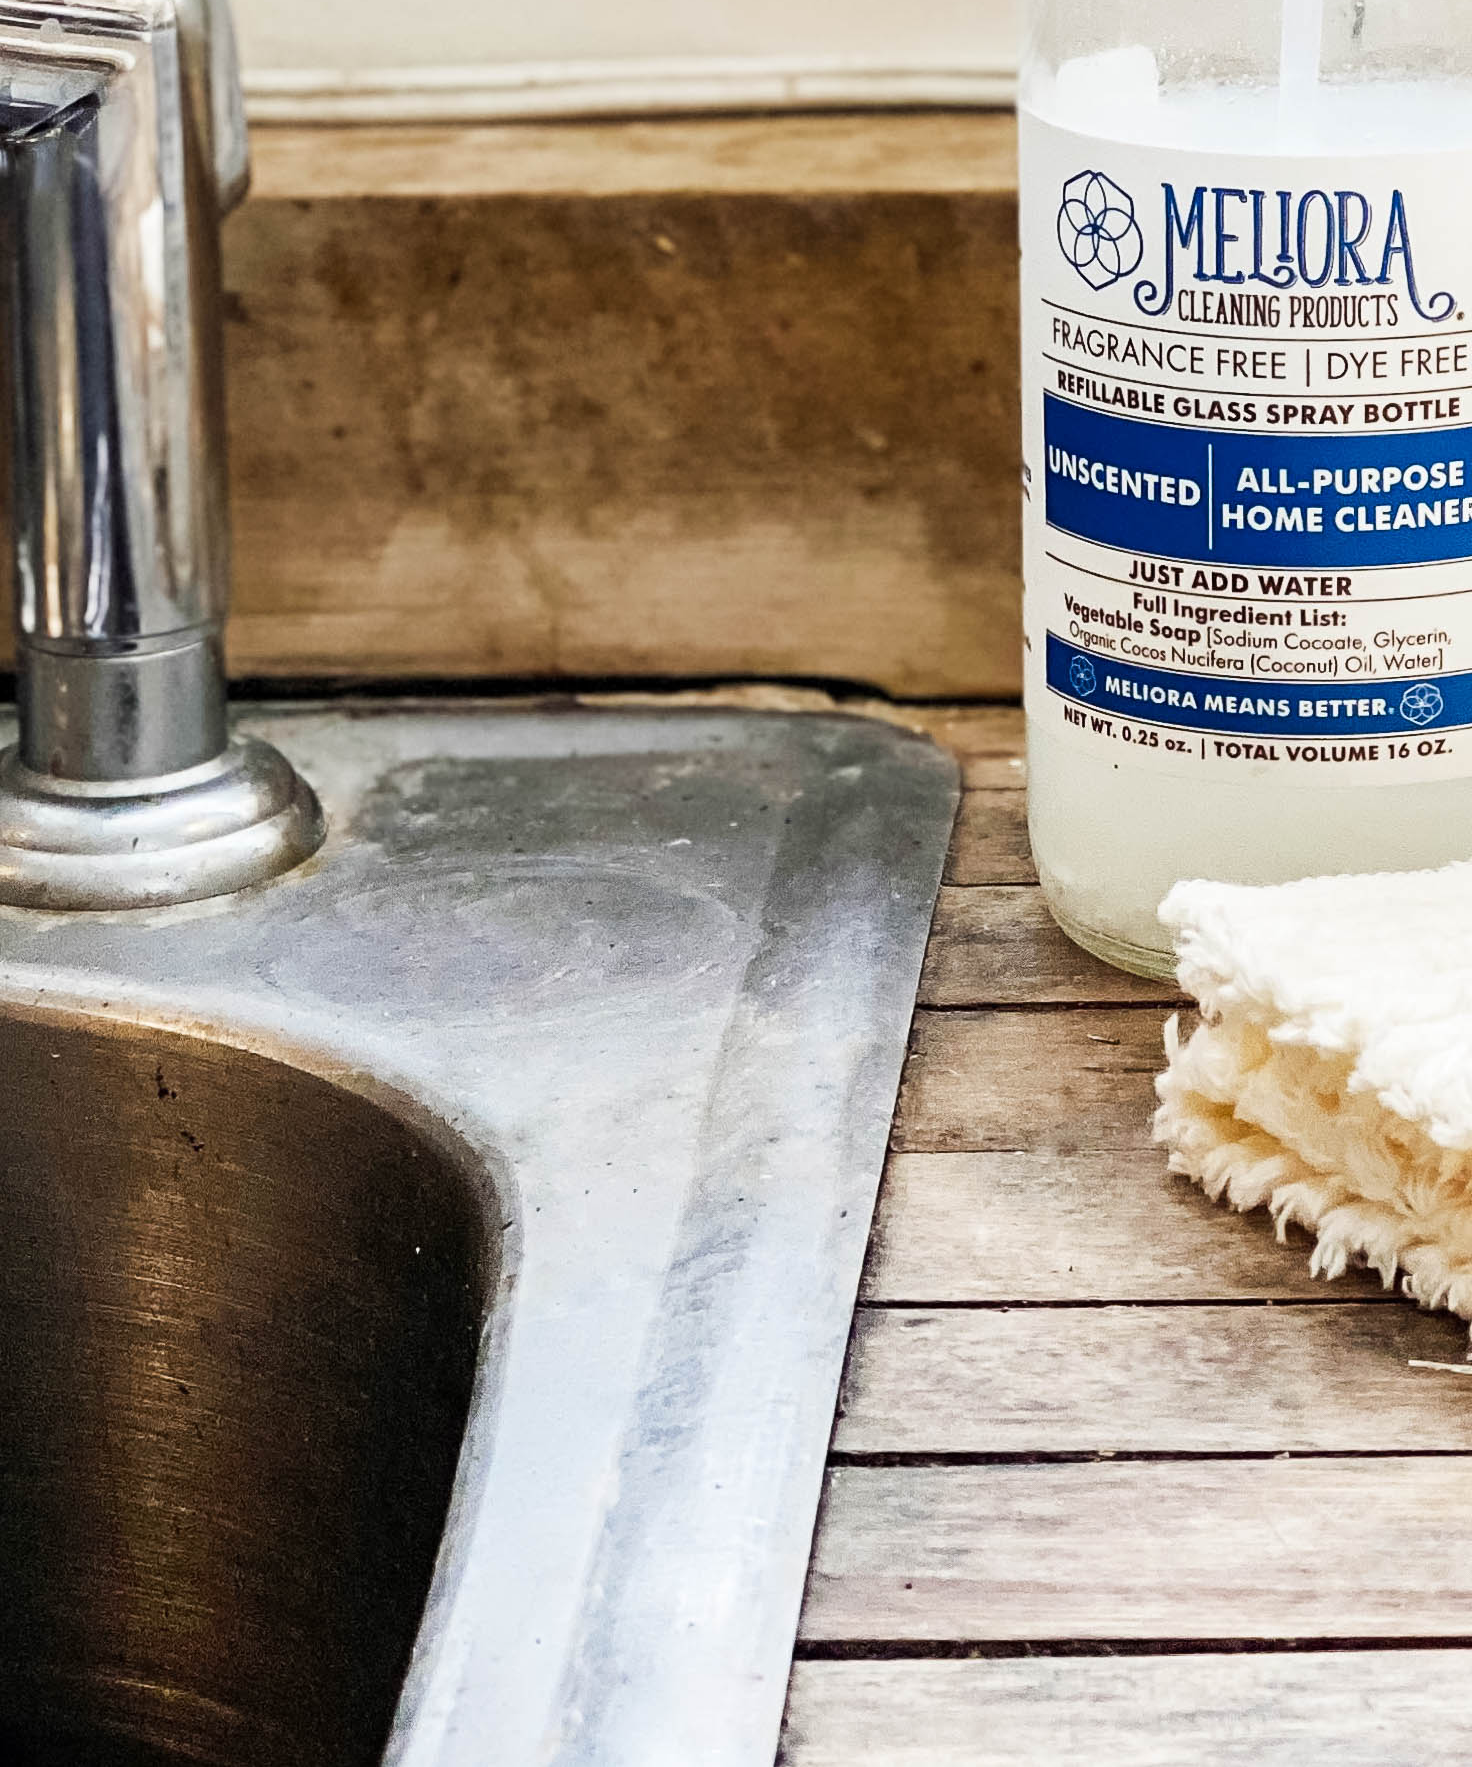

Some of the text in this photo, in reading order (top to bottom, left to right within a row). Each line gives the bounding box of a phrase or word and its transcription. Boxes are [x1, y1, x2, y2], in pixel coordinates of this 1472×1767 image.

[1178, 289, 1399, 328] CLEANING PRODUCTS
[1052, 317, 1468, 380] FRAGRANCE FREE DYE FREE
[1057, 369, 1460, 425] REFILLABLE GLASS SPRAY BOTTLE
[1049, 445, 1201, 507] UNSCENTED
[1236, 460, 1465, 495] ALL-PURPOSE
[1221, 503, 1324, 533] HOME
[1129, 560, 1353, 597] JUST ADD WATER
[1064, 593, 1453, 653] Vegetable Soap [Sodium Cocoate, Glycerin,
[1133, 592, 1348, 628] Full Ingredient List:
[1069, 620, 1444, 678] Organic Cocos Nucifera (Coconut) Oil, Water]
[1105, 675, 1198, 710] MELIORA
[1204, 694, 1291, 717] MEANS
[1064, 705, 1454, 763] NET WT. 0.25 oz. TOTAL VOLUME 16 OZ.
